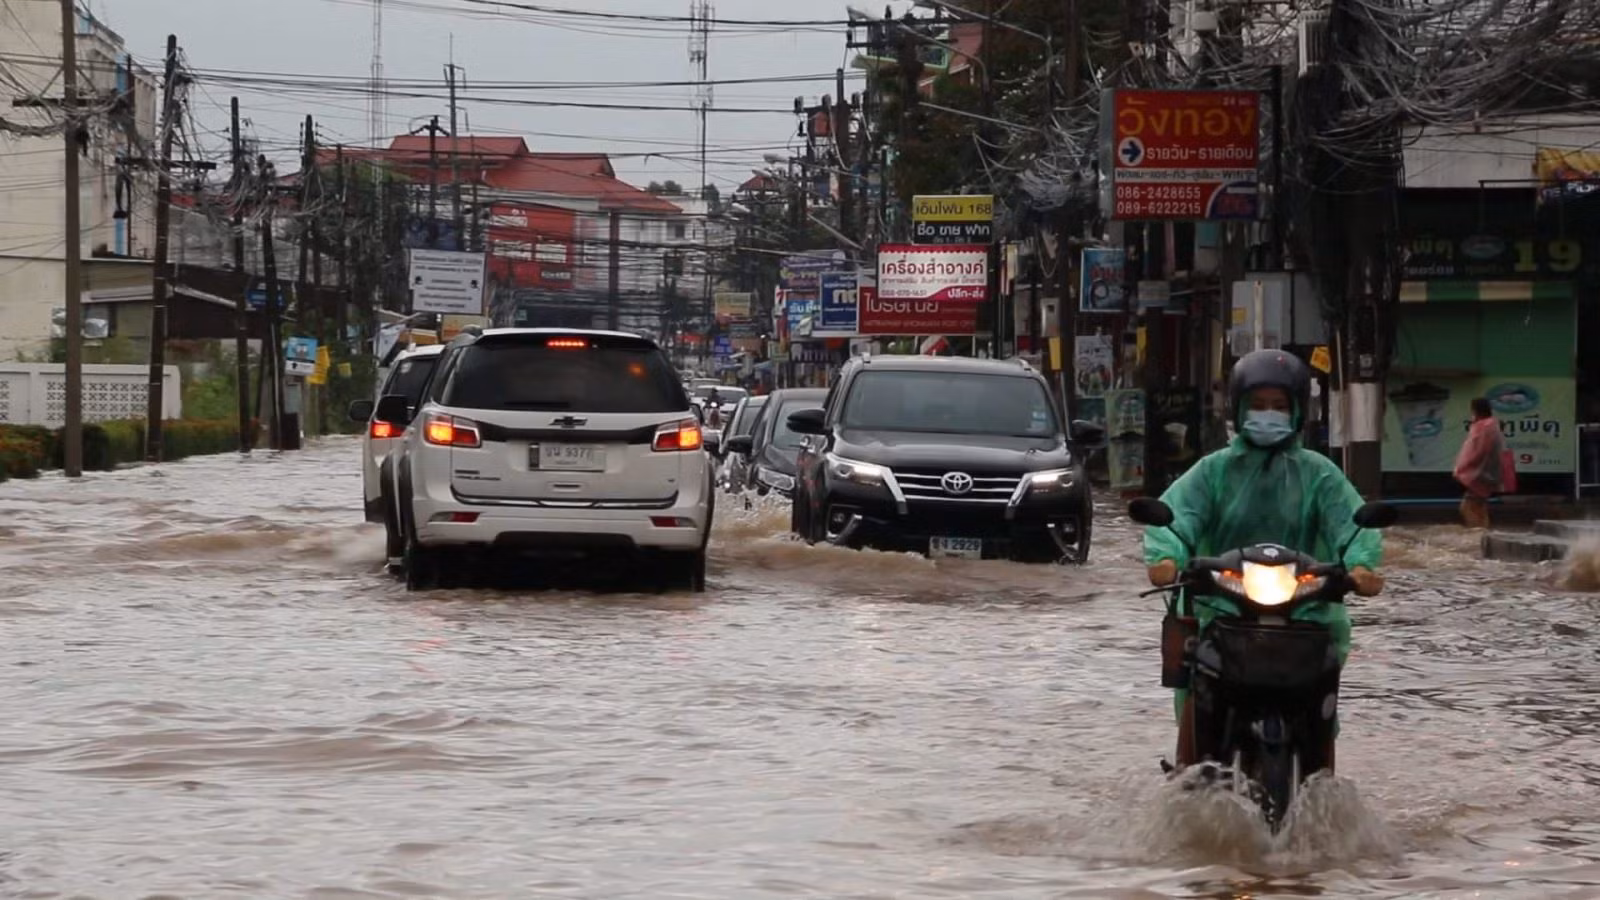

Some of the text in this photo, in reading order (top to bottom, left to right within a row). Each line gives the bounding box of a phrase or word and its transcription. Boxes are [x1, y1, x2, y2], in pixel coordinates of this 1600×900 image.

[1118, 96, 1255, 137] วังทอง
[1116, 186, 1200, 199] 086-2428655
[968, 204, 992, 215] 168
[1116, 202, 1200, 215] 089-6222215
[882, 254, 983, 275] เครื่องสำอางค์
